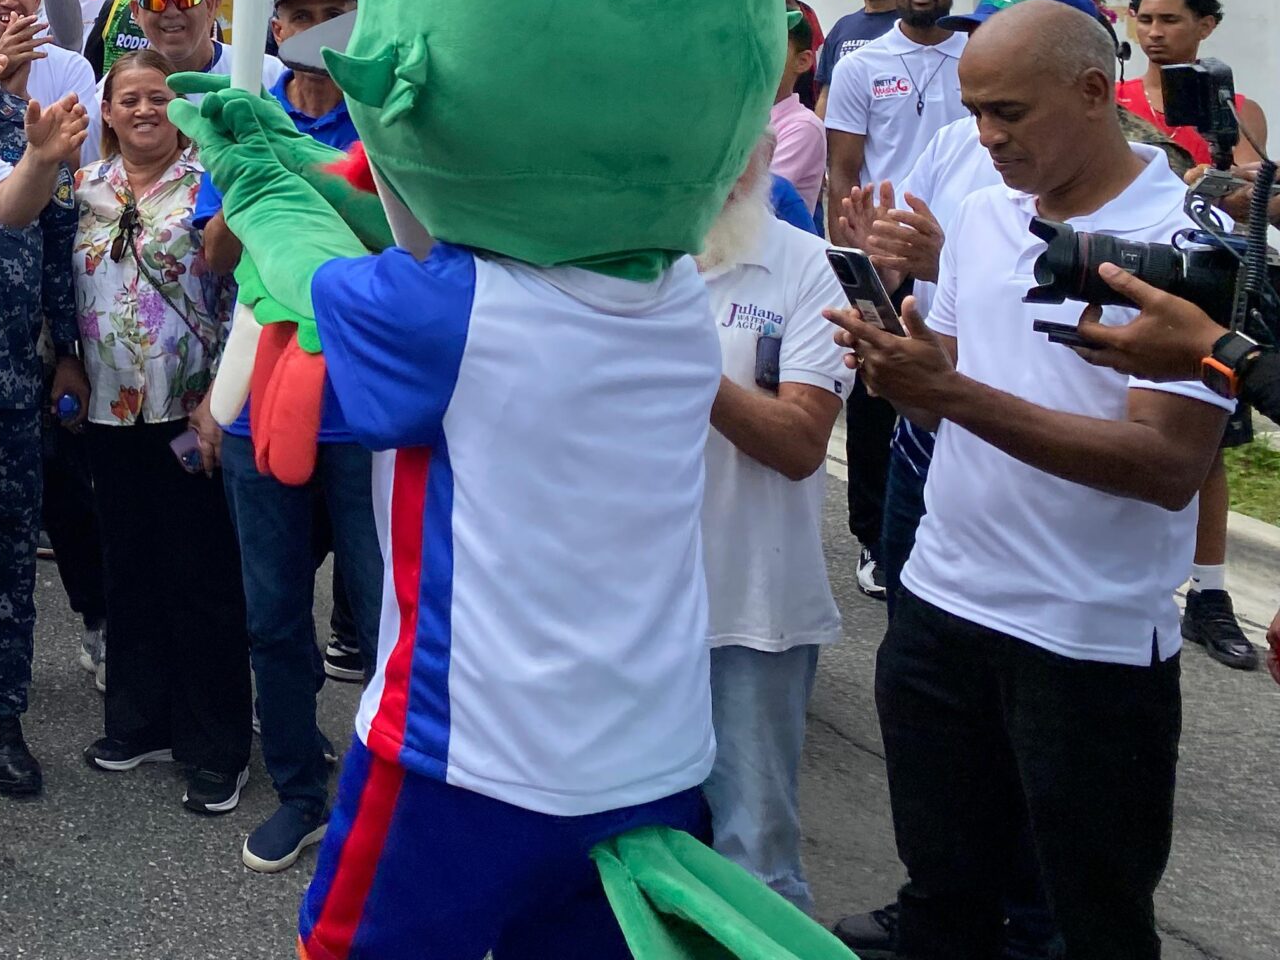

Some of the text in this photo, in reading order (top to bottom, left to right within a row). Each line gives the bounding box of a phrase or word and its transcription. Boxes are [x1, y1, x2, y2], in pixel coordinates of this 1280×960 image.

[721, 302, 784, 328] Juliana
[737, 314, 766, 326] WATER
[735, 321, 762, 333] AGUA
